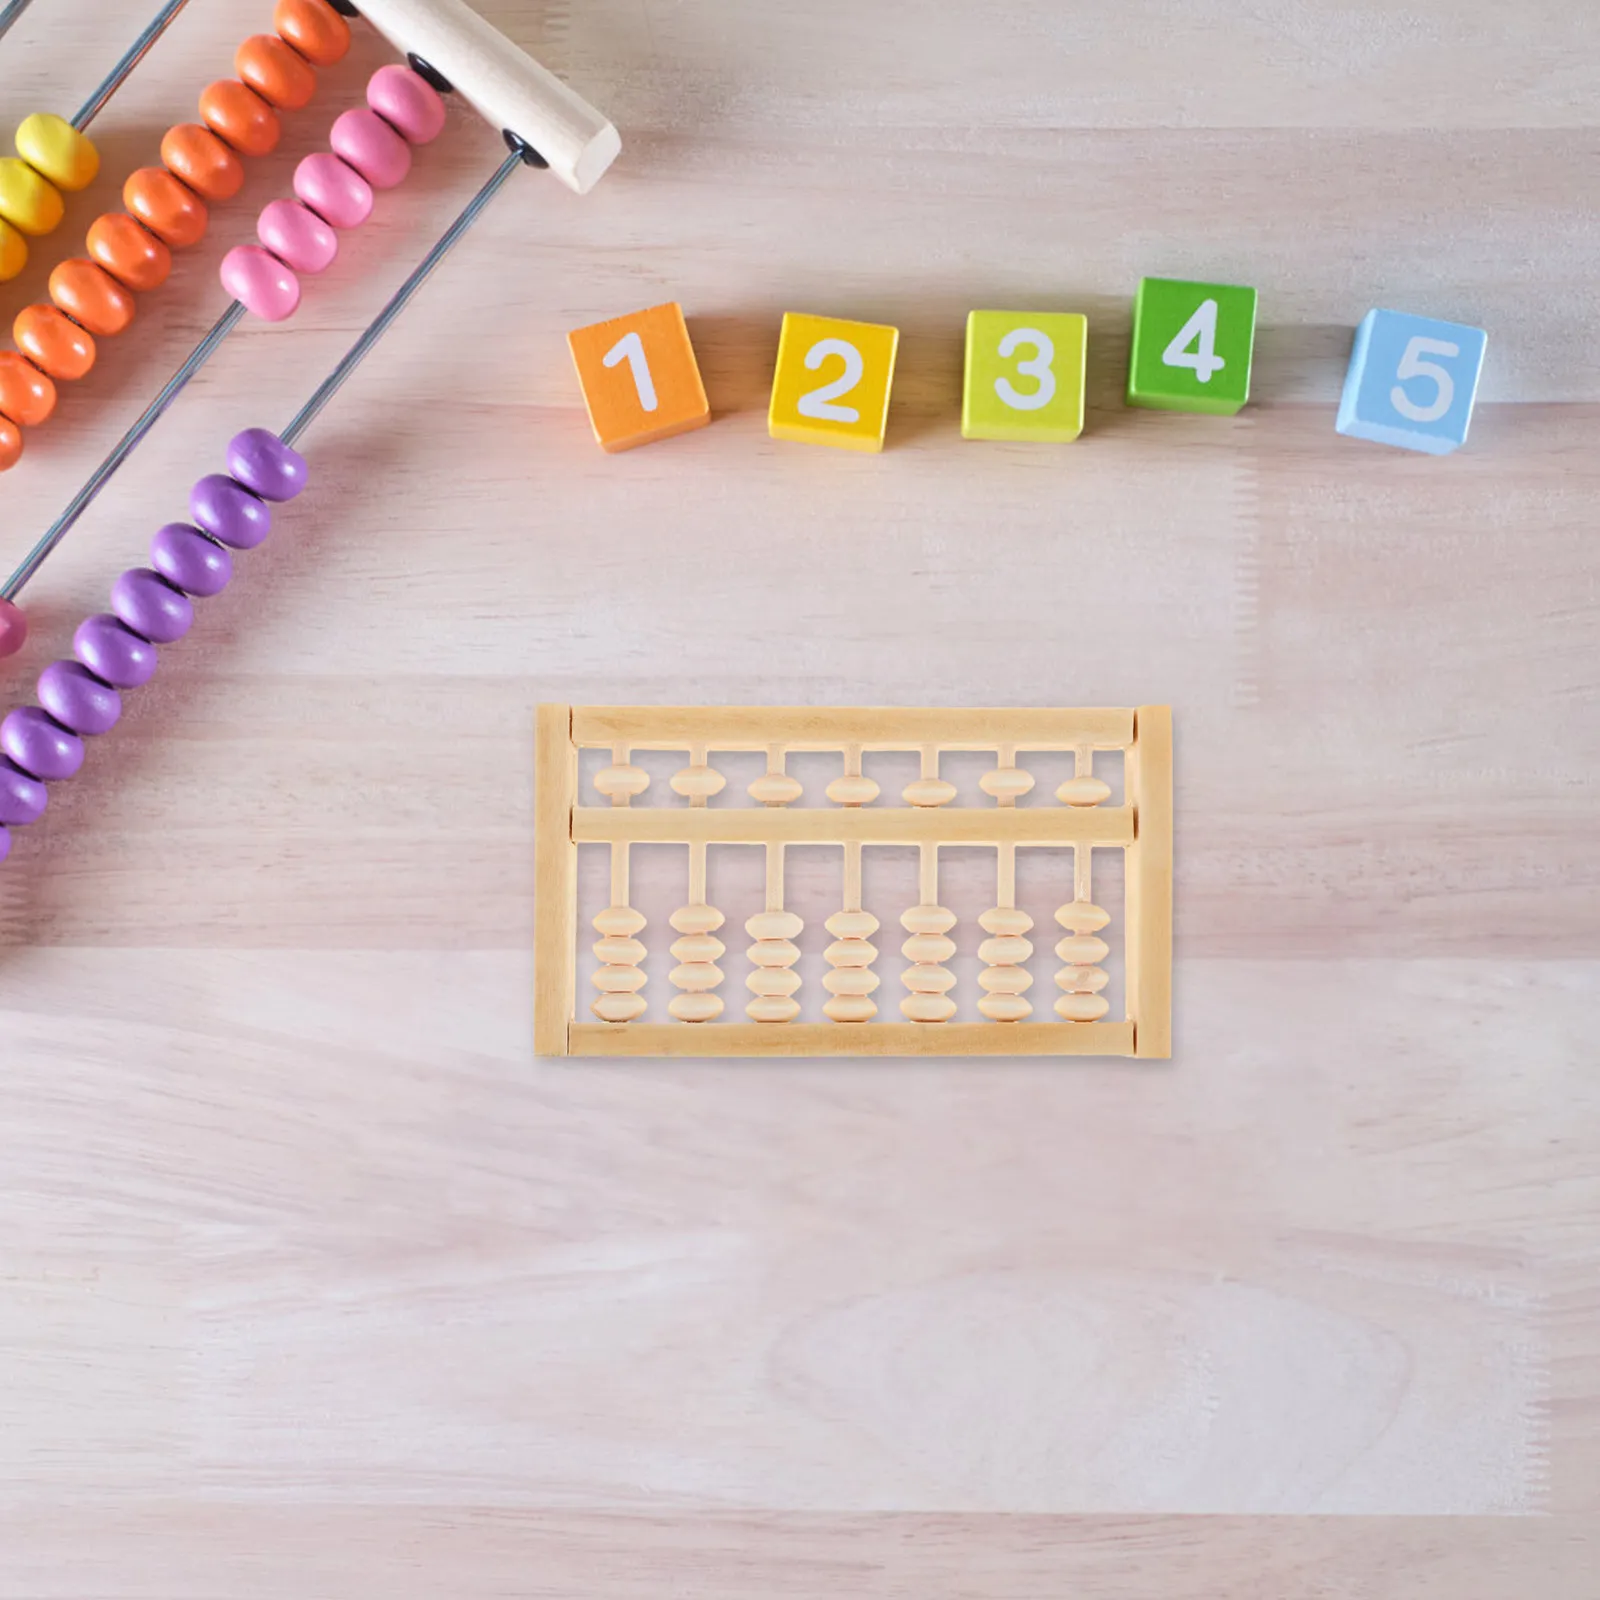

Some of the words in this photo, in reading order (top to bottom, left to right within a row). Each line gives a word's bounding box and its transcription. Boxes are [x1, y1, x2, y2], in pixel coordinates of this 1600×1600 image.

[602, 331, 659, 412] 1
[796, 337, 864, 424] 2
[993, 327, 1057, 411] 3
[1161, 297, 1226, 384] 4
[1389, 336, 1460, 423] 5
